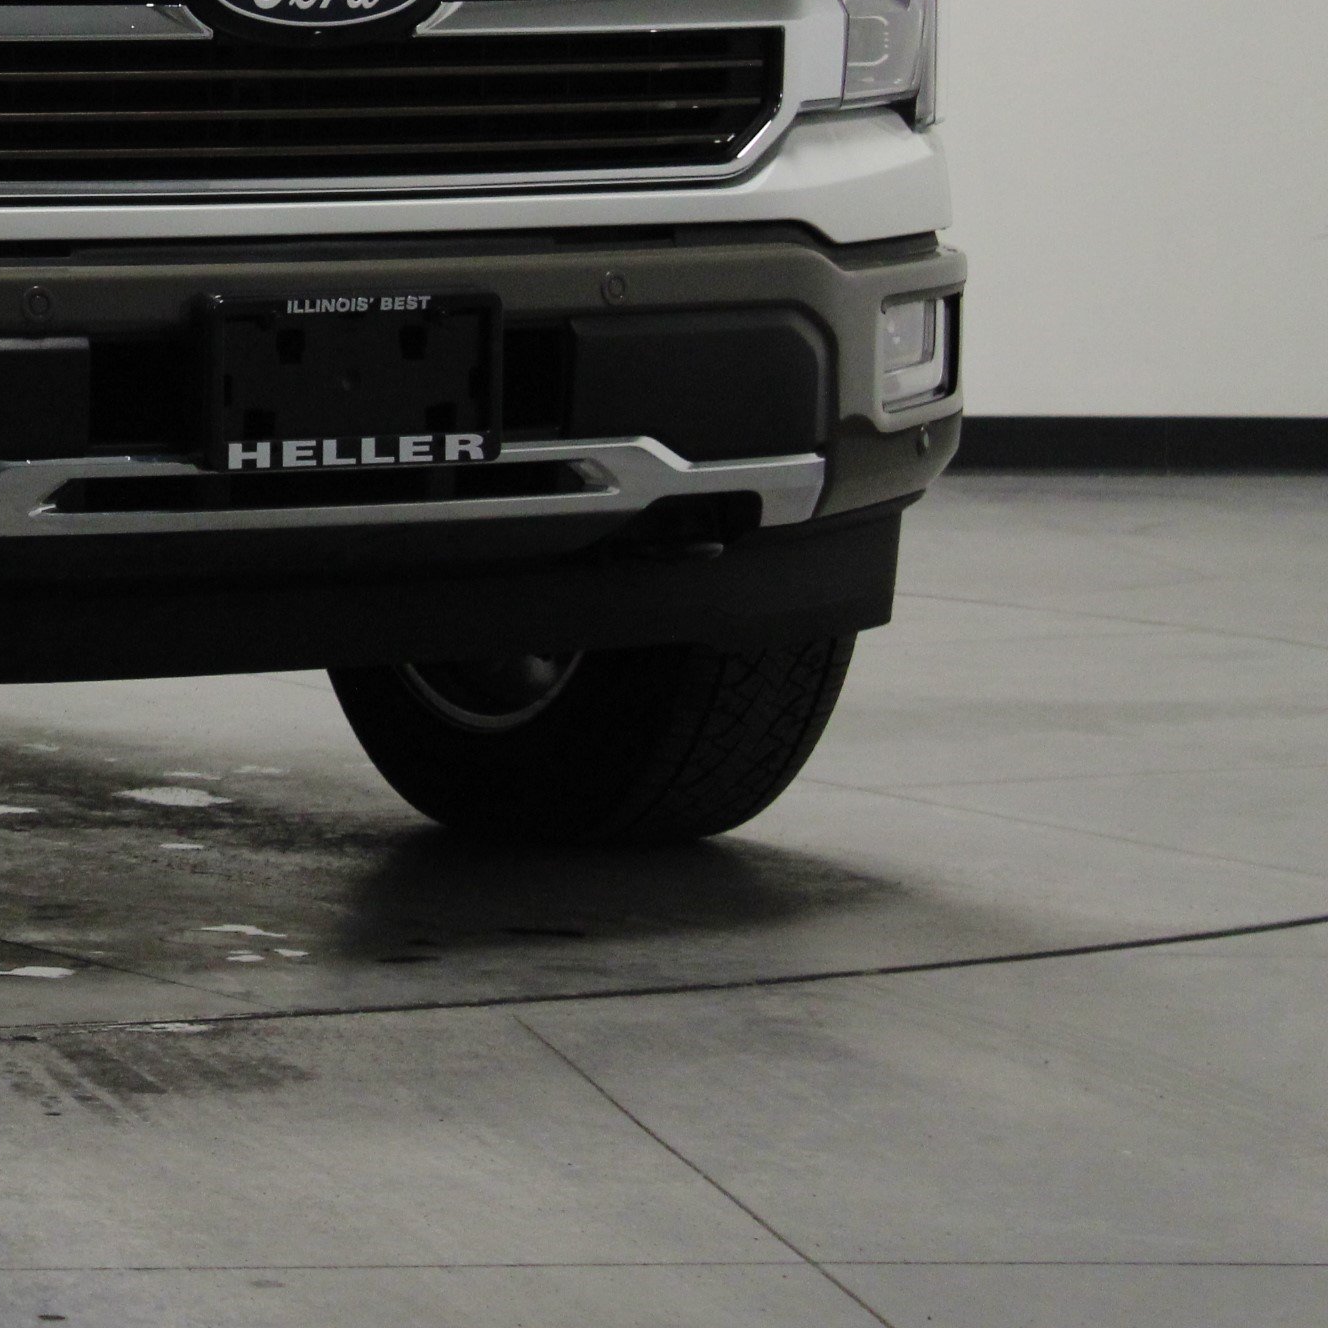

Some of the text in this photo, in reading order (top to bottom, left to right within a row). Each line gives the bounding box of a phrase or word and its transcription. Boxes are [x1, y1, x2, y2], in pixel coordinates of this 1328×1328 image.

[286, 294, 432, 315] ILLINOIS' BEST
[227, 432, 485, 470] HELLER
